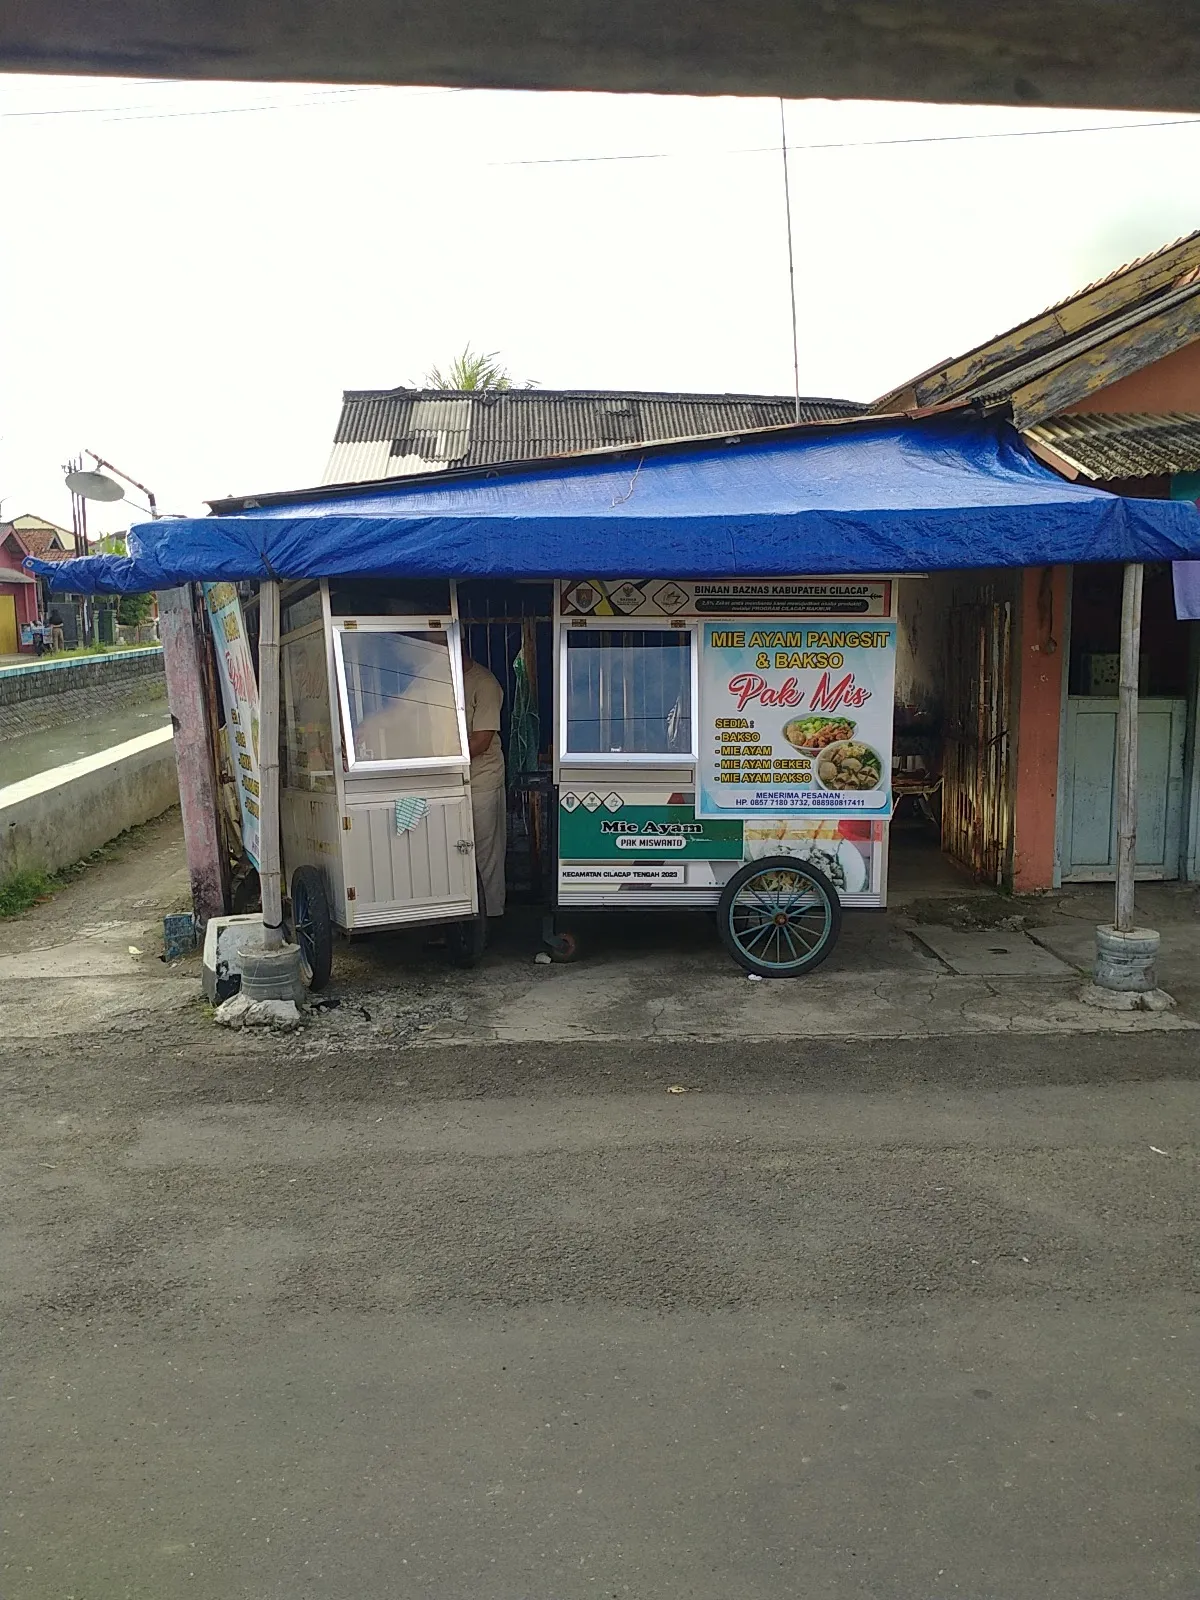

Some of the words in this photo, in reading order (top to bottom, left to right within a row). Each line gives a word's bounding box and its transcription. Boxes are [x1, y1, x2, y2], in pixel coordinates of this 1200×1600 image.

[694, 585, 730, 594] BINAAN
[732, 586, 769, 594] BAZNAS
[772, 586, 827, 595] KABUPATEN
[829, 586, 869, 595] CILACAP
[711, 631, 746, 648] MIE
[749, 631, 803, 648] AYAM
[806, 631, 890, 648] PANGSIT
[755, 652, 771, 669] &
[775, 653, 844, 669] BAKSO
[728, 673, 804, 711] Pak
[809, 671, 872, 712] Mis
[715, 718, 748, 729] SEDIA
[721, 732, 760, 742] BAKSO
[721, 746, 741, 756] MIE
[742, 746, 772, 756] AYAM
[721, 759, 741, 769] MIE
[742, 759, 772, 769] AYAM
[773, 759, 811, 769] CEKER
[721, 773, 741, 783] MIE
[742, 773, 772, 783] AYAM
[773, 773, 812, 783] BAKSO
[601, 821, 638, 833] Mie
[641, 821, 703, 835] Ayam
[620, 838, 637, 847] PAK
[639, 838, 683, 847] MISWANTO
